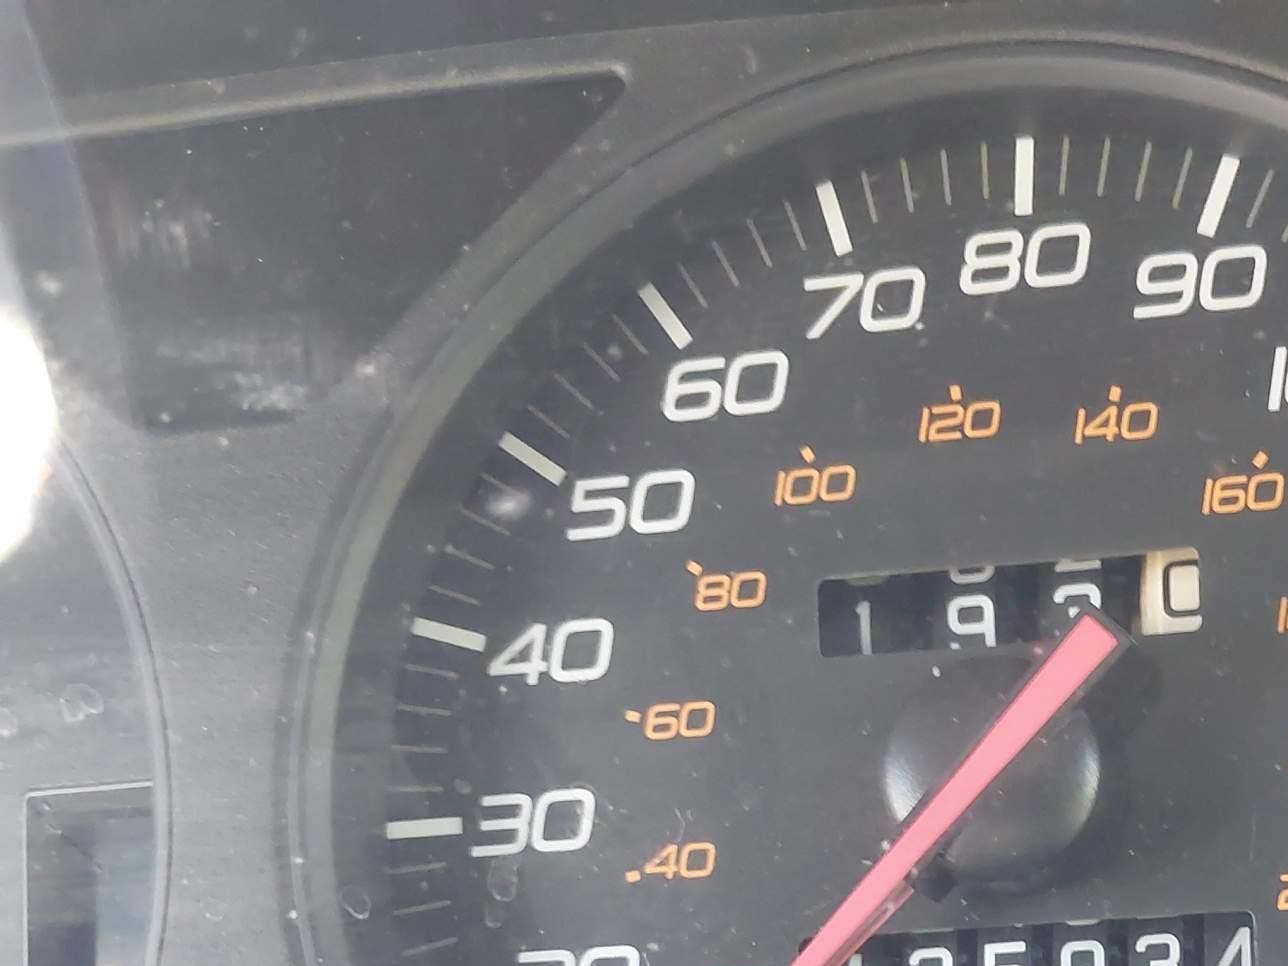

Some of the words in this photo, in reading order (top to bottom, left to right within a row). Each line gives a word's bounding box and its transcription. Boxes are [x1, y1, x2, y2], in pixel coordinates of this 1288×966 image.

[960, 223, 1090, 294] 80
[1134, 245, 1266, 318] 90
[804, 268, 925, 339] 70
[663, 351, 788, 421] 60
[919, 402, 1000, 442] 120
[1075, 403, 1157, 444] 140
[567, 470, 694, 540] 50
[775, 465, 855, 505] 100
[1202, 473, 1284, 514] 160
[695, 571, 766, 610] 80
[490, 618, 613, 685] 40
[645, 702, 715, 739] 60
[472, 788, 595, 856] 30
[644, 842, 715, 879] 40
